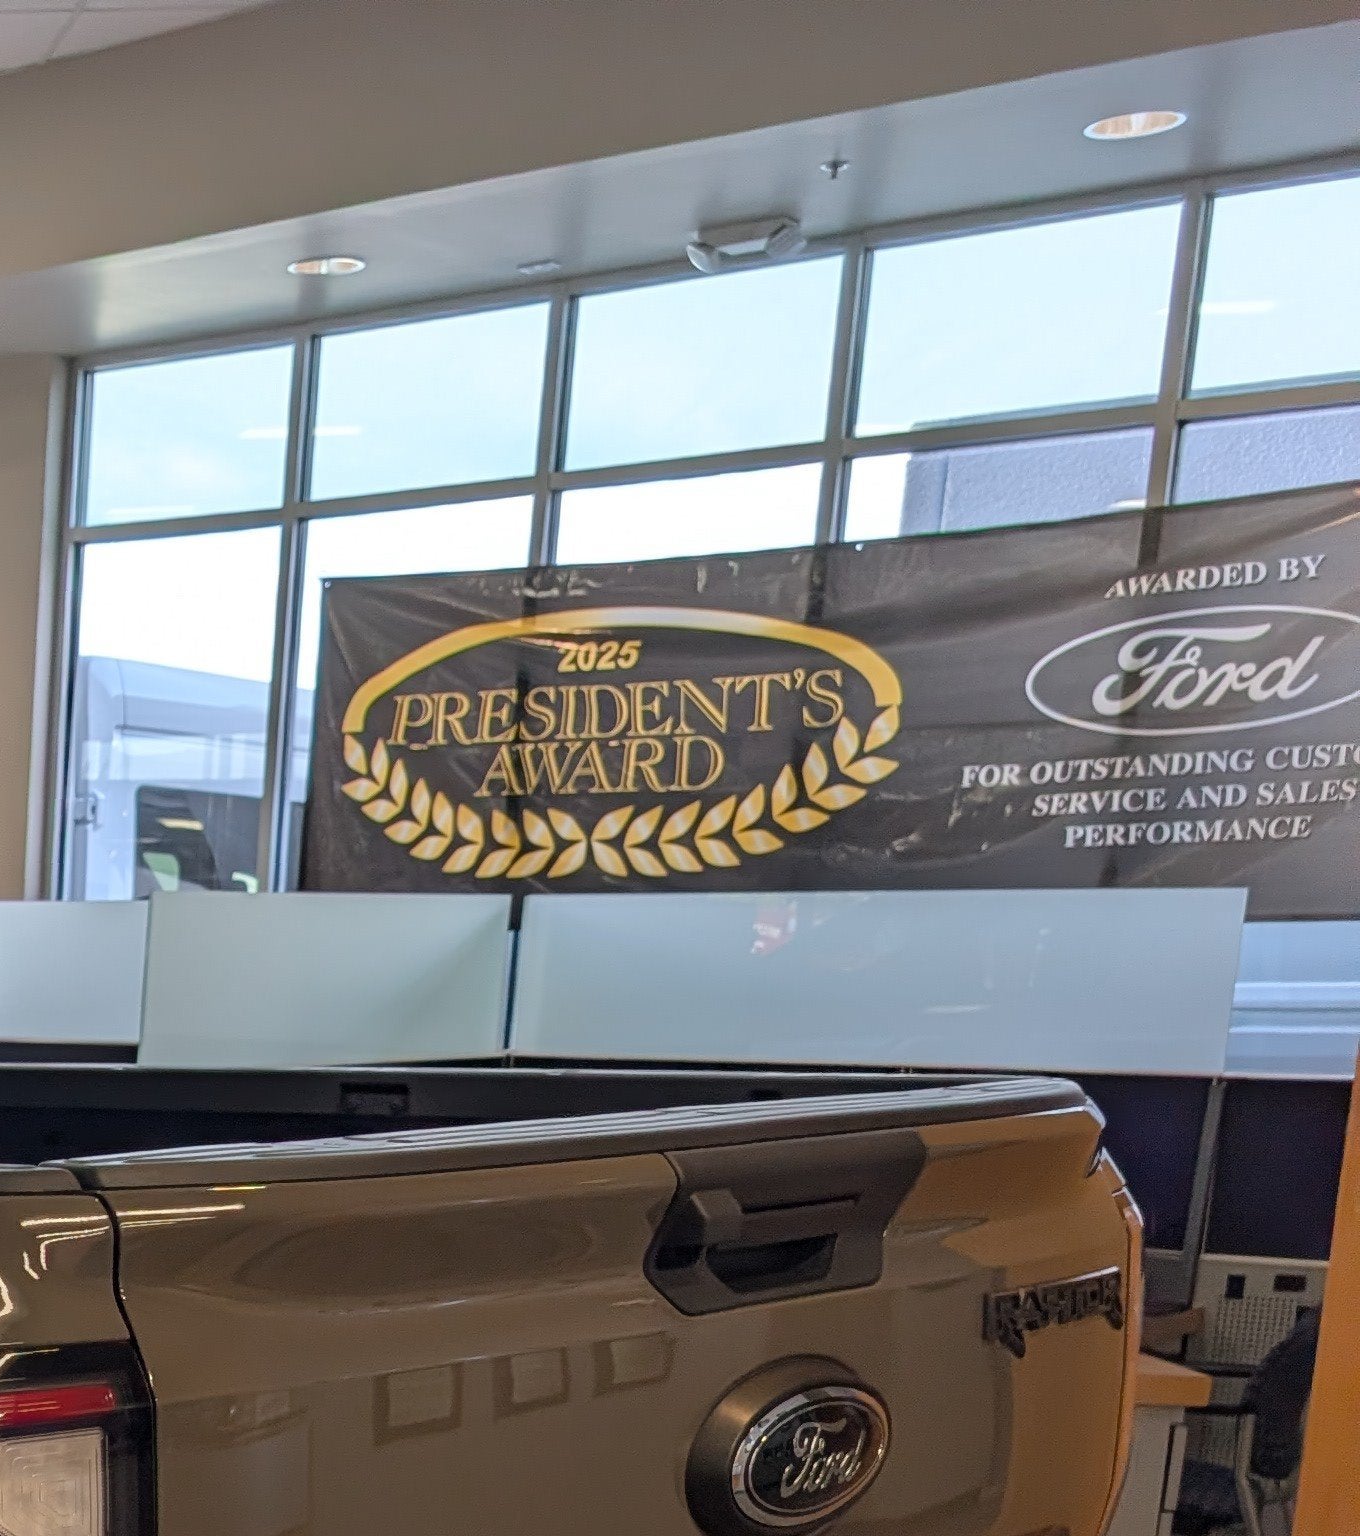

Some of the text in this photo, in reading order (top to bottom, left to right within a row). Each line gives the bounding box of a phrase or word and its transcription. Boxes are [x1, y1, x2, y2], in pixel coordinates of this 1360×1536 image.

[1104, 553, 1326, 600] AWARDED BY
[557, 640, 642, 673] 2025
[1092, 622, 1325, 717] Ford
[386, 668, 845, 747] PRESIDENT'S
[473, 734, 725, 799] AWARD
[960, 763, 1021, 790] FOR
[1029, 747, 1256, 785] OUTSTANDING
[1031, 777, 1359, 818] SERVICE AND SALES
[1063, 814, 1313, 849] PERFORMANCE
[779, 1417, 868, 1499] Ford
